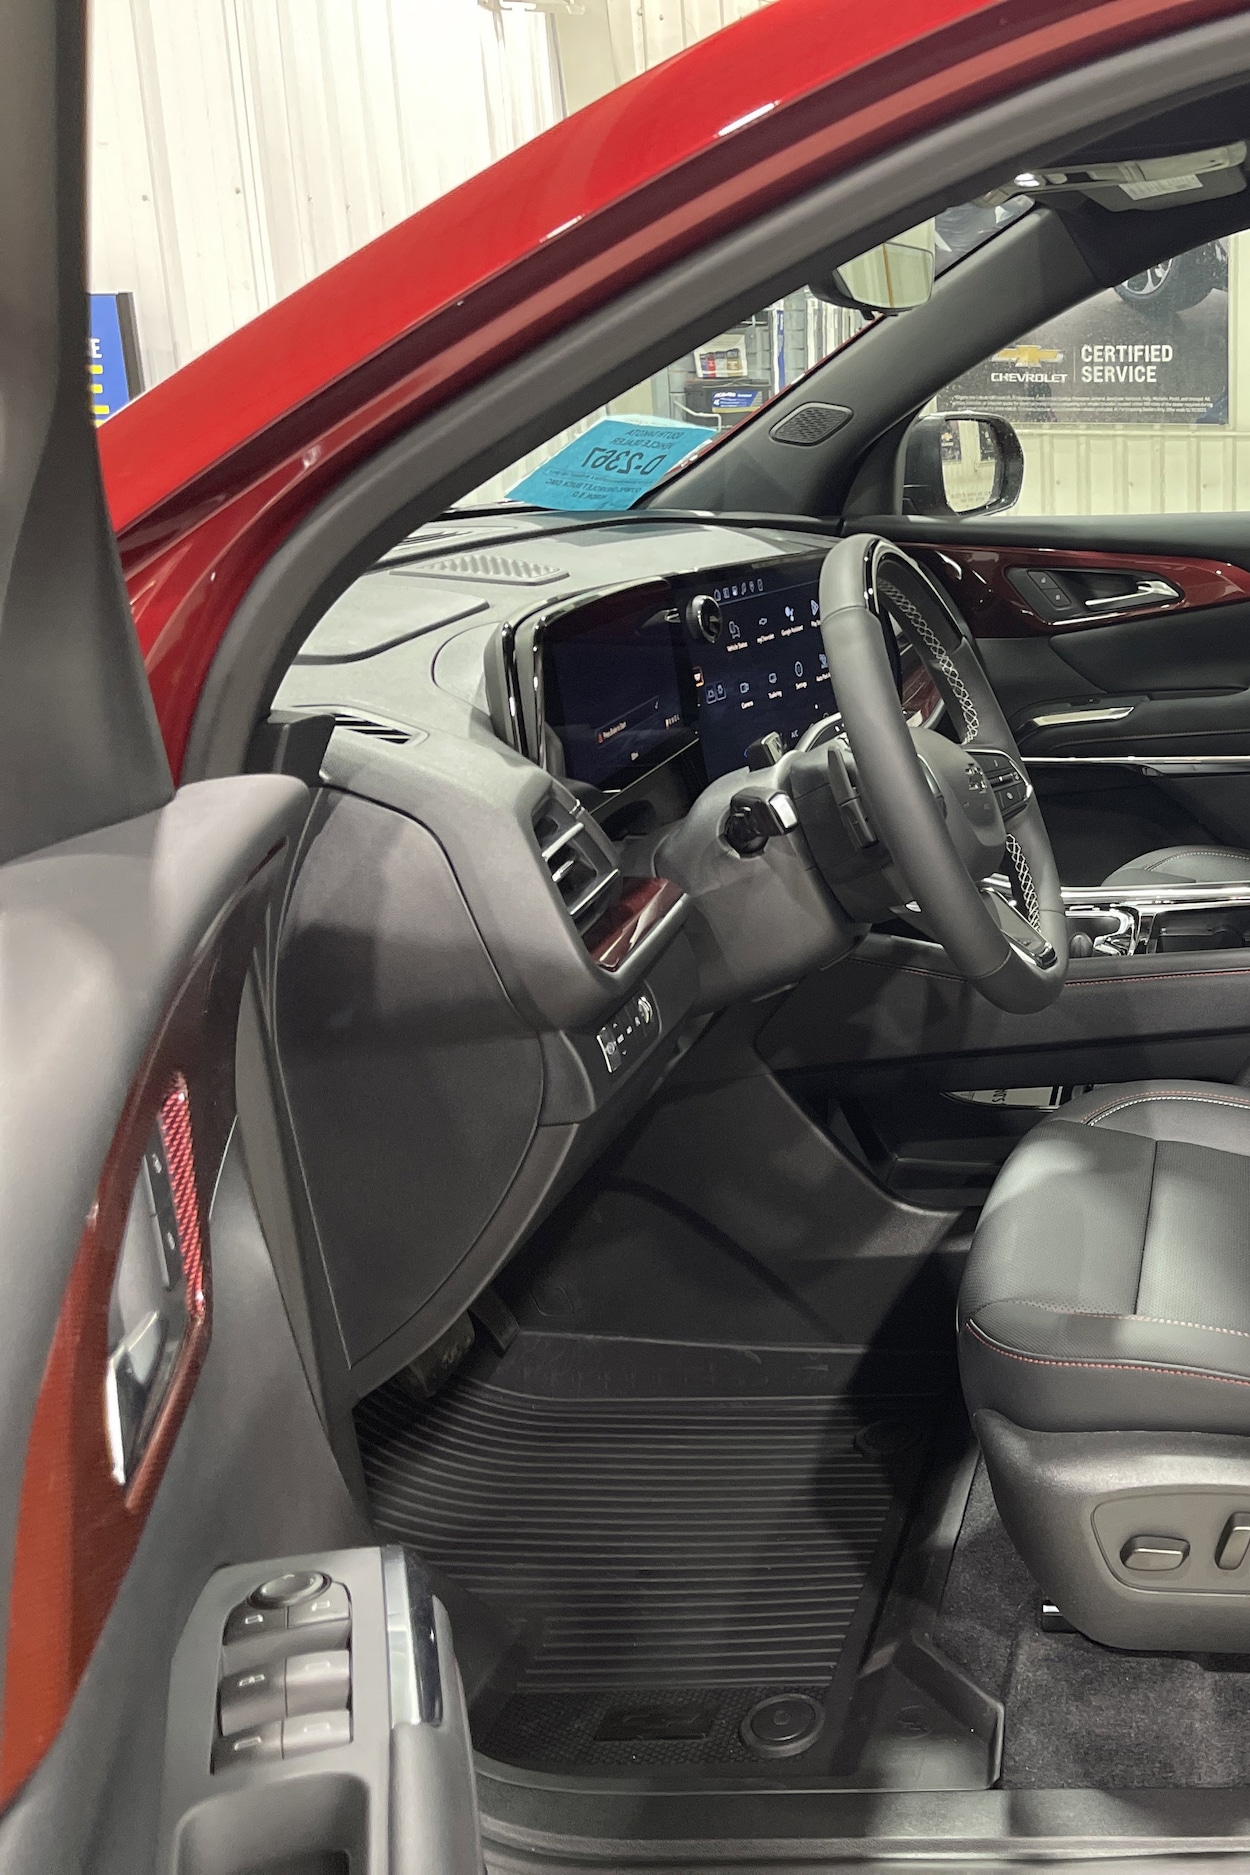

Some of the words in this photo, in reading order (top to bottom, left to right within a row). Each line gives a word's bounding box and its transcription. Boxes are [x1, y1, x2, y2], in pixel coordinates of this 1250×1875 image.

[1080, 344, 1173, 363] CERTIFIED
[990, 372, 1068, 383] CHEVROLET
[1081, 365, 1157, 383] SERVICE
